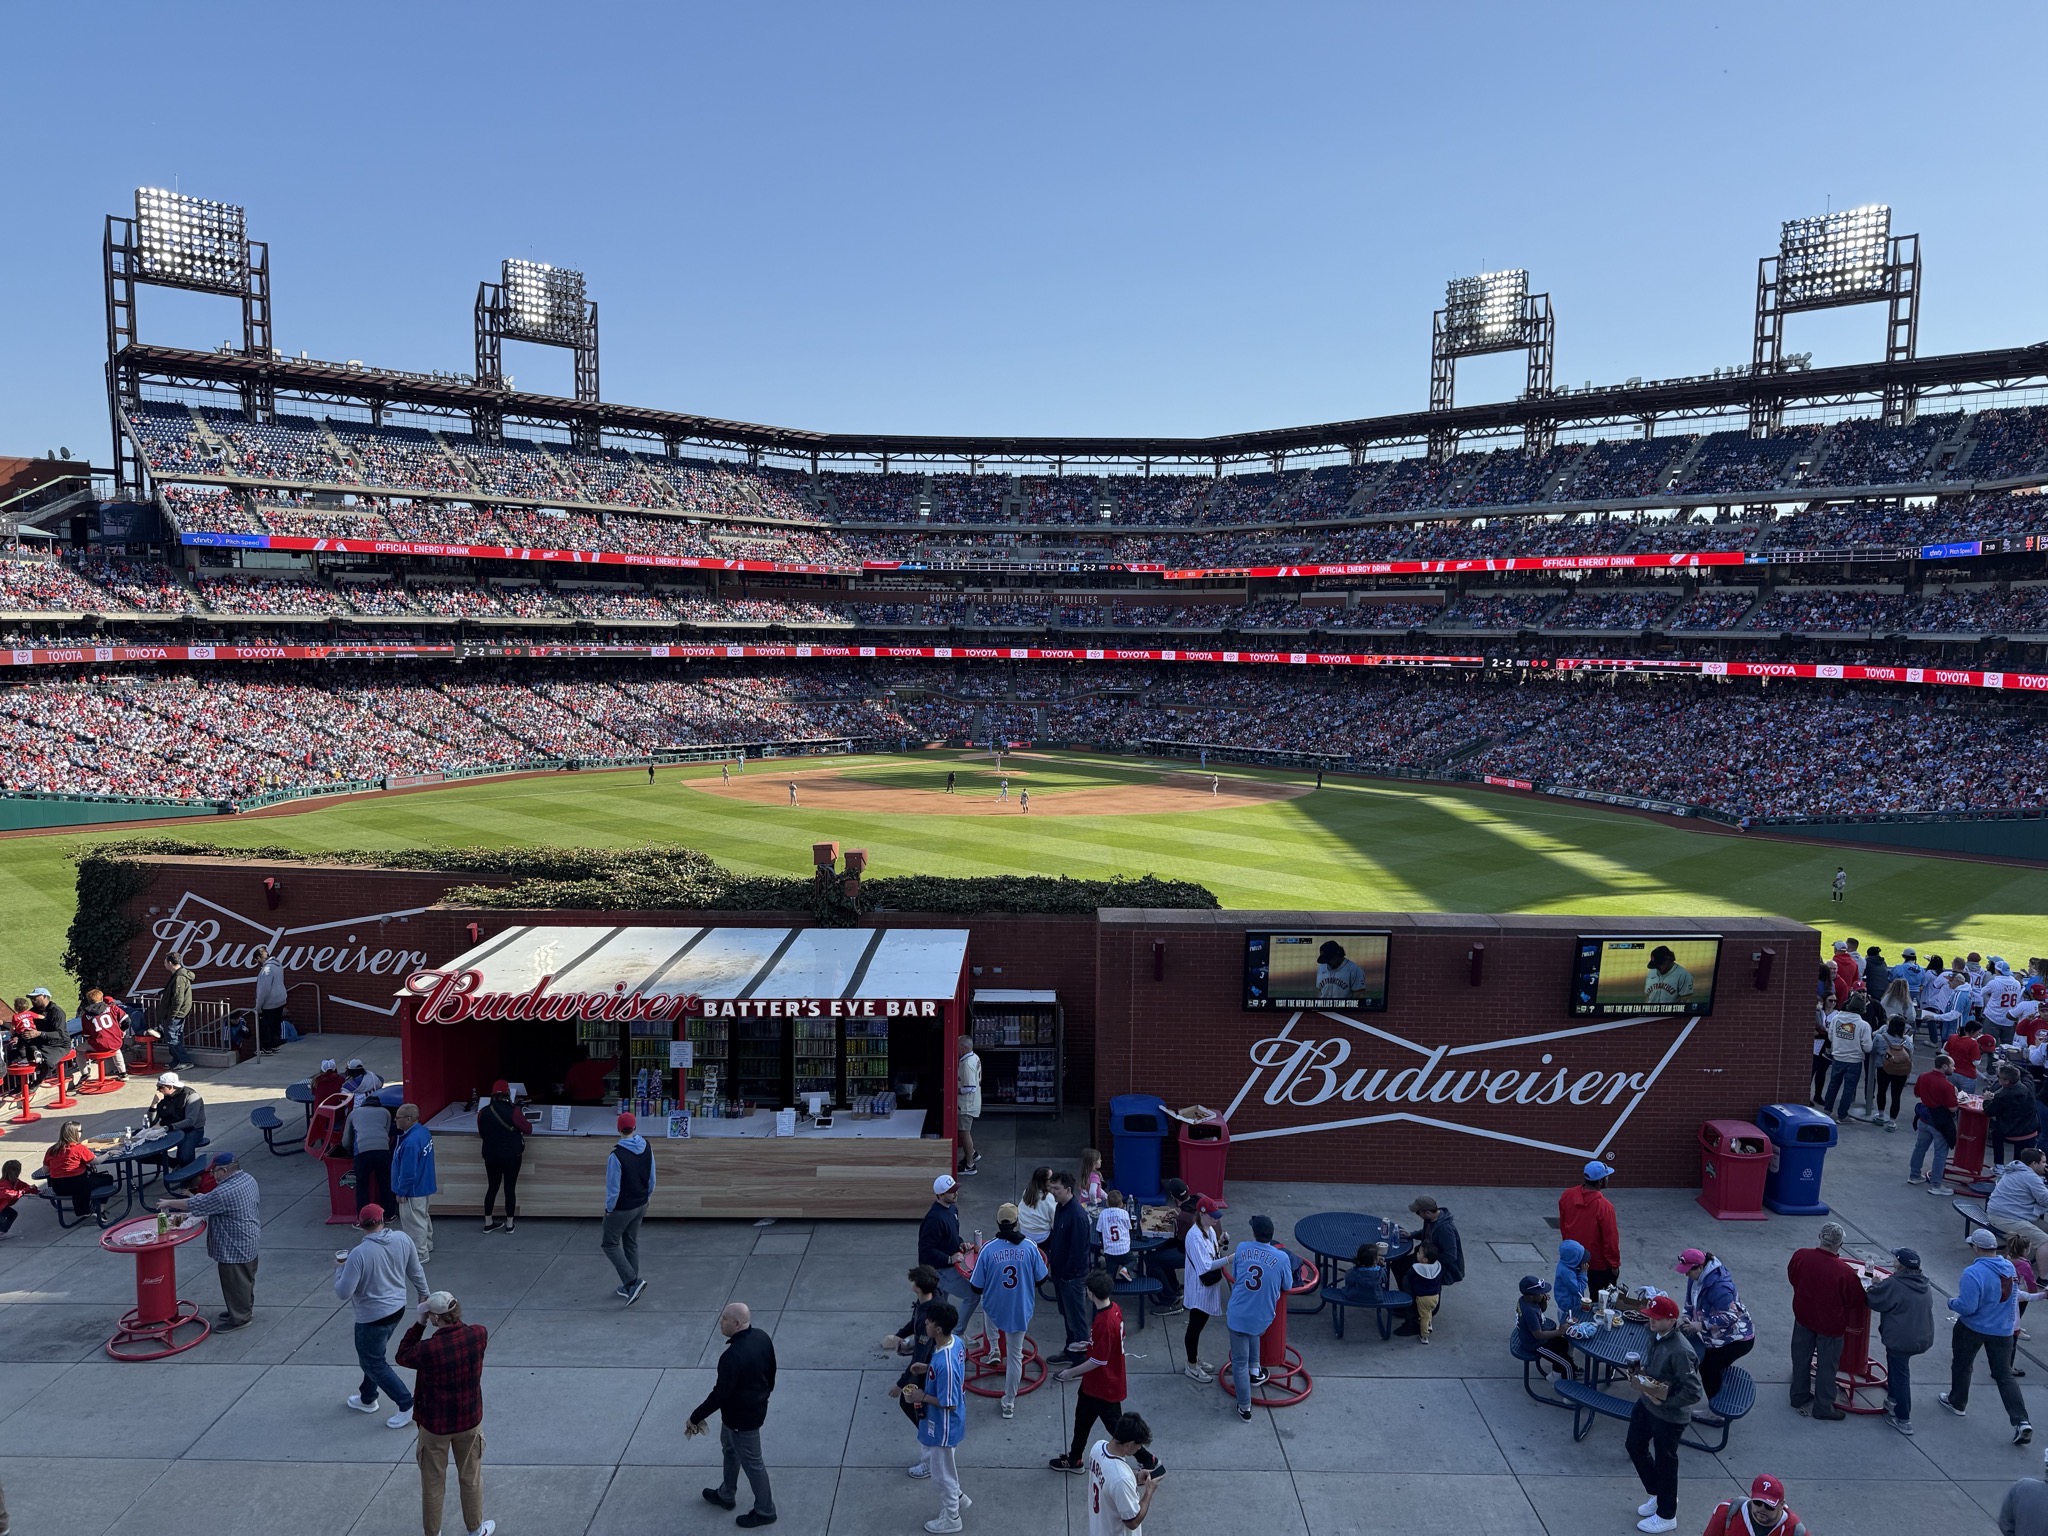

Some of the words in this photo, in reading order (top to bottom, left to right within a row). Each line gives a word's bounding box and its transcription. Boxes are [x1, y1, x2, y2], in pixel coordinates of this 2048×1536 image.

[376, 542, 412, 552] OFFICIAL
[414, 544, 446, 554] ENERGY
[448, 546, 470, 554] DRINK
[624, 556, 654, 564] OFFICIAL
[656, 557, 678, 565] ENERGY
[680, 558, 700, 566] DRINK
[1542, 558, 1576, 568] OFFICIAL
[1578, 557, 1610, 566] ENERGY
[1611, 556, 1636, 565] DRINK
[1318, 566, 1346, 574] OFFICIAL
[1348, 565, 1370, 573] ENERGY
[1372, 564, 1392, 572] DRINK
[930, 594, 953, 602] HOME
[974, 594, 988, 602] THE
[993, 595, 1053, 603] PHILADELPH
[1060, 596, 1098, 604] PHILLIES
[47, 650, 83, 661] TOYOTA
[125, 649, 168, 658] TOYOTA
[236, 648, 286, 657] TOYOTA
[888, 648, 922, 656] TOYOTA
[965, 649, 998, 657] TOYOTA
[1041, 650, 1074, 658] TOYOTA
[1185, 652, 1213, 660] TOYOTA
[1250, 654, 1279, 662] TOYOTA
[1318, 655, 1351, 663] TOYOTA
[1492, 658, 1512, 667] 2-2
[1746, 665, 1796, 675] TOYOTA
[1864, 668, 1895, 679] TOYOTA
[1935, 672, 1970, 683] TOYOTA
[395, 778, 415, 786] TOYOTA
[1516, 781, 1532, 789] TOYOTA
[152, 916, 428, 975] Budweiser
[1324, 979, 1348, 990] FRANCISCO
[1652, 983, 1675, 995] FRANCISCO
[404, 968, 702, 1024] Budweiser
[2000, 994, 2017, 1007] 26
[1276, 999, 1287, 1007] VISIT
[1296, 999, 1305, 1007] NEW
[1306, 999, 1314, 1007] ERA
[1315, 999, 1333, 1007] PHILLIES
[1334, 999, 1345, 1007] TEAM
[1346, 999, 1359, 1007] STORE
[1604, 1004, 1613, 1013] VISIT
[1615, 1004, 1623, 1013] THE
[1624, 1004, 1632, 1013] NEW
[1633, 1004, 1641, 1013] ERA
[1642, 1004, 1660, 1013] PHILLIES
[1660, 1004, 1672, 1013] TEAM
[1673, 1004, 1685, 1013] STORE
[703, 1000, 820, 1018] BATTER’S
[830, 1000, 875, 1018] EYE
[886, 1000, 937, 1018] BAR
[92, 1014, 113, 1032] 10
[1249, 1037, 1647, 1107] Budweiser
[1110, 1226, 1120, 1242] 5
[992, 1248, 1025, 1264] HARPER
[1241, 1250, 1278, 1269] HARPER
[1002, 1265, 1018, 1289] 3
[1244, 1264, 1264, 1292] 3
